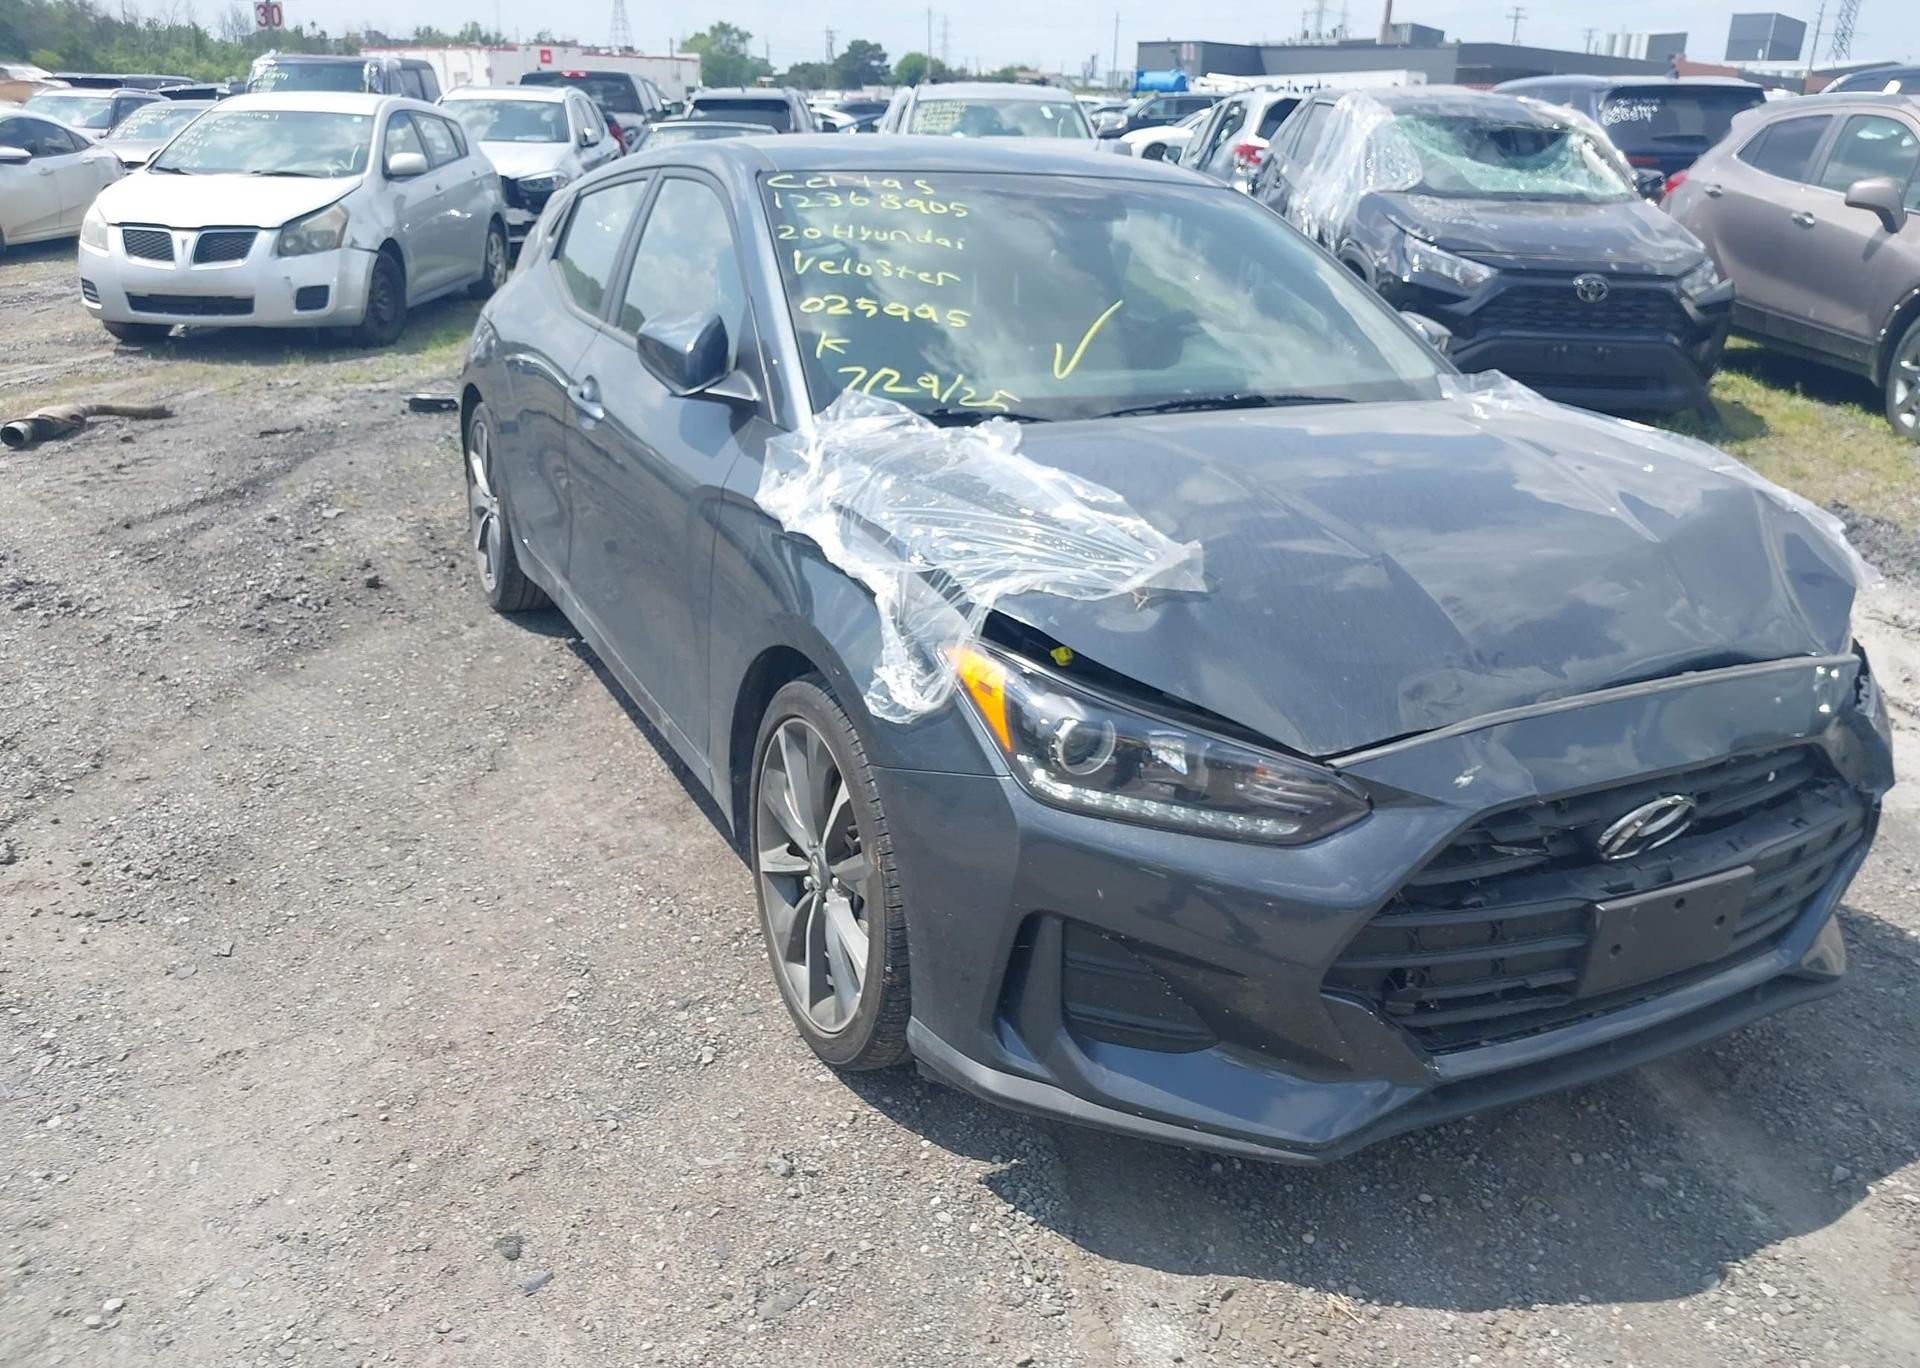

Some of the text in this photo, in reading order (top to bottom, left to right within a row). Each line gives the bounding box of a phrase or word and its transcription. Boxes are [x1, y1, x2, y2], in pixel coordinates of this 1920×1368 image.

[257, 4, 282, 27] 30
[774, 191, 968, 217] 12368905
[778, 225, 965, 250] 20 Hyundai
[799, 295, 970, 328] 025995
[815, 331, 850, 359] K
[838, 366, 1021, 411] 7/29/25
